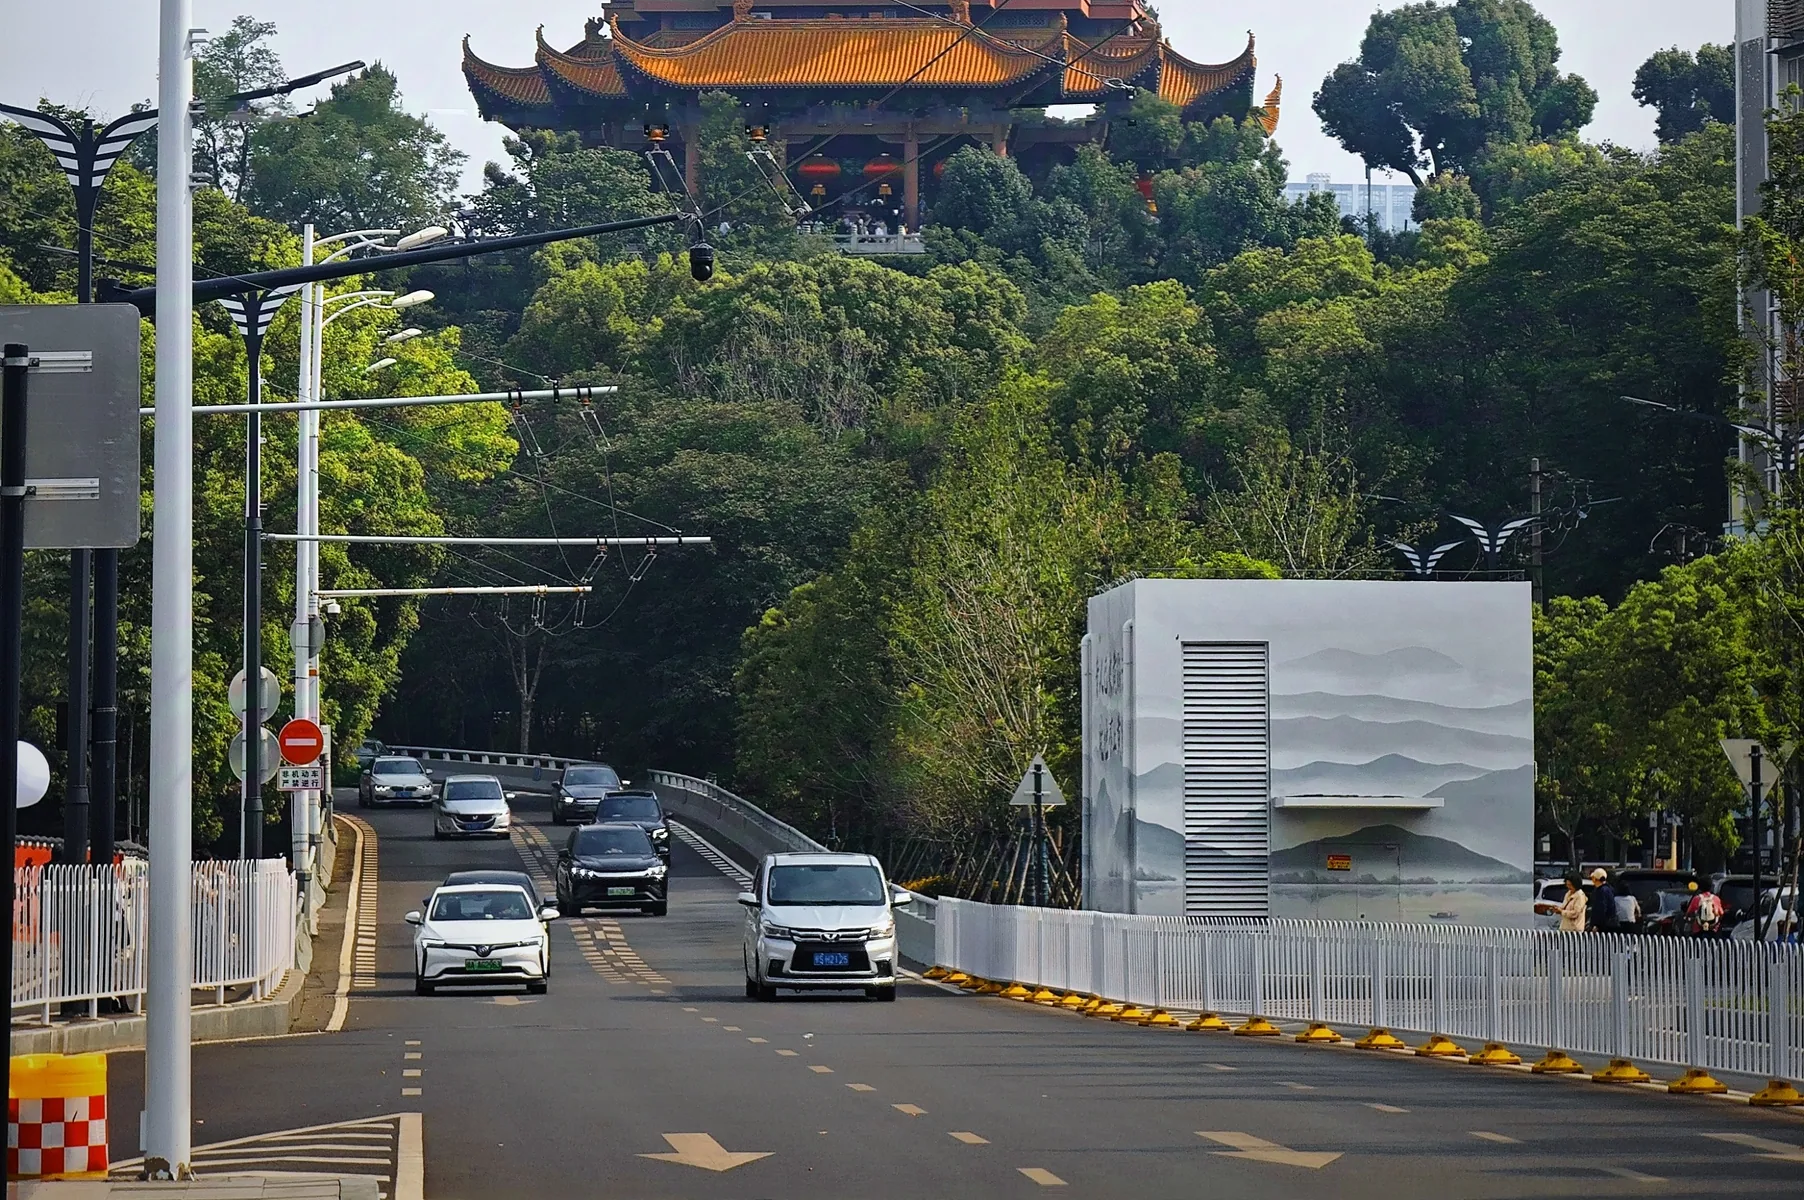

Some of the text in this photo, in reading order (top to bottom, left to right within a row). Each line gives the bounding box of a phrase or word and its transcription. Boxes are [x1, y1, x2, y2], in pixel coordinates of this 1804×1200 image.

[282, 770, 319, 778] 非机动车
[282, 779, 319, 788] 严禁逆行
